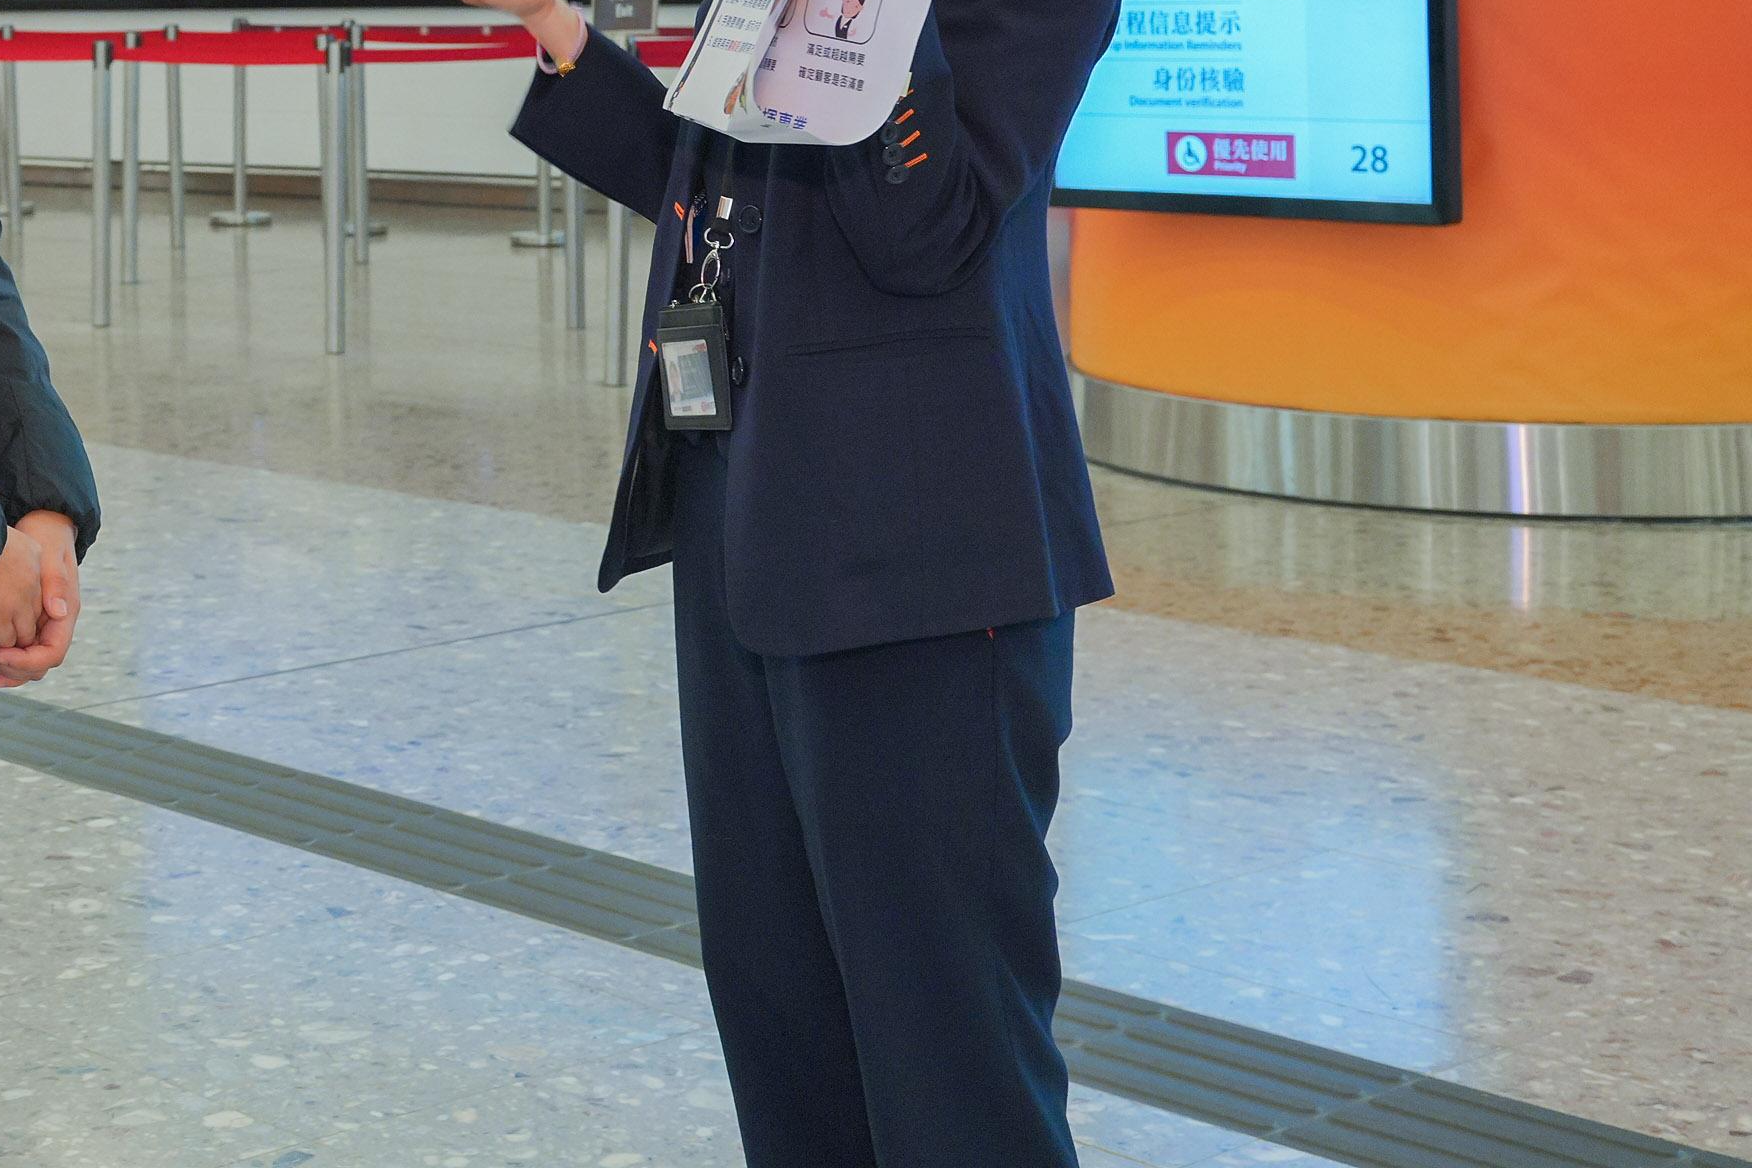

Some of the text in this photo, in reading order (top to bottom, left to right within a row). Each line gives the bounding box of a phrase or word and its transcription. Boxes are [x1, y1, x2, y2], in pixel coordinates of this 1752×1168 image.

[1116, 10, 1241, 35] 程信息提示
[1125, 40, 1184, 50] Information
[1187, 40, 1242, 51] Reminders
[1154, 66, 1245, 92] 身份核驗
[1129, 95, 1244, 108] Document verification
[1351, 144, 1388, 173] 28
